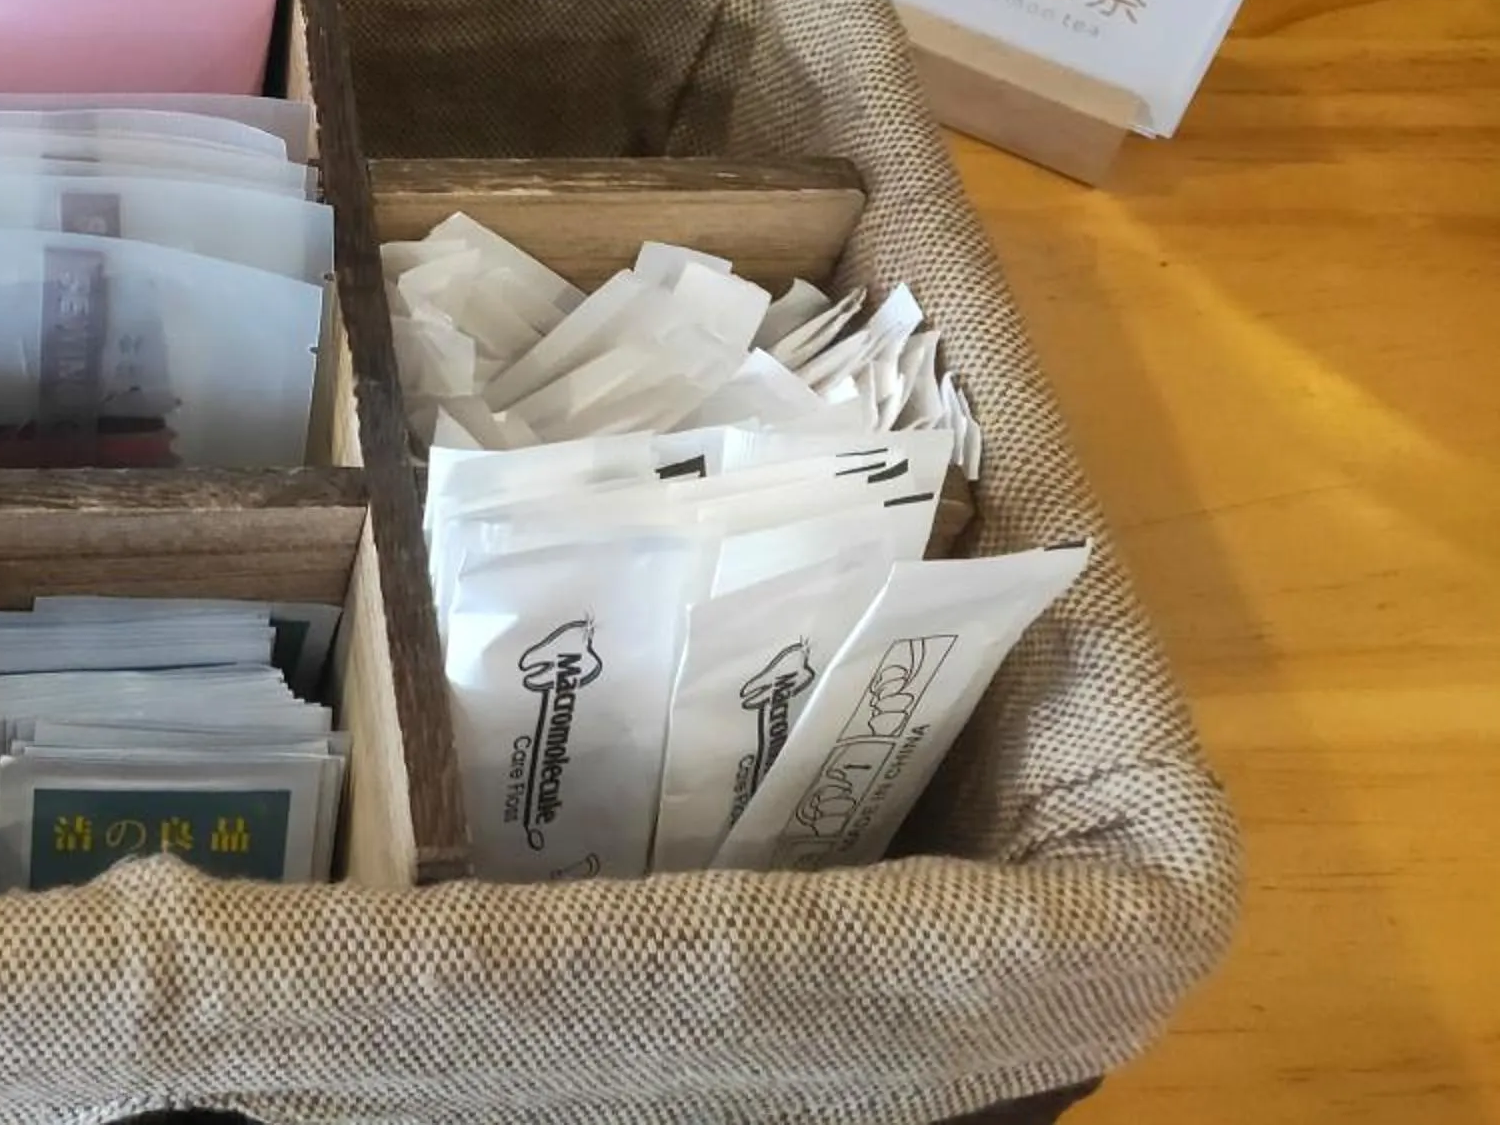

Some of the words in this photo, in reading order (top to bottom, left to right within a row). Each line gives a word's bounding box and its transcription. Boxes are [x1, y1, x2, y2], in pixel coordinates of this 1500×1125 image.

[1061, 12, 1100, 39] tea
[509, 735, 532, 779] Care
[536, 653, 582, 825] Macromolecule
[883, 723, 931, 781] CHINA
